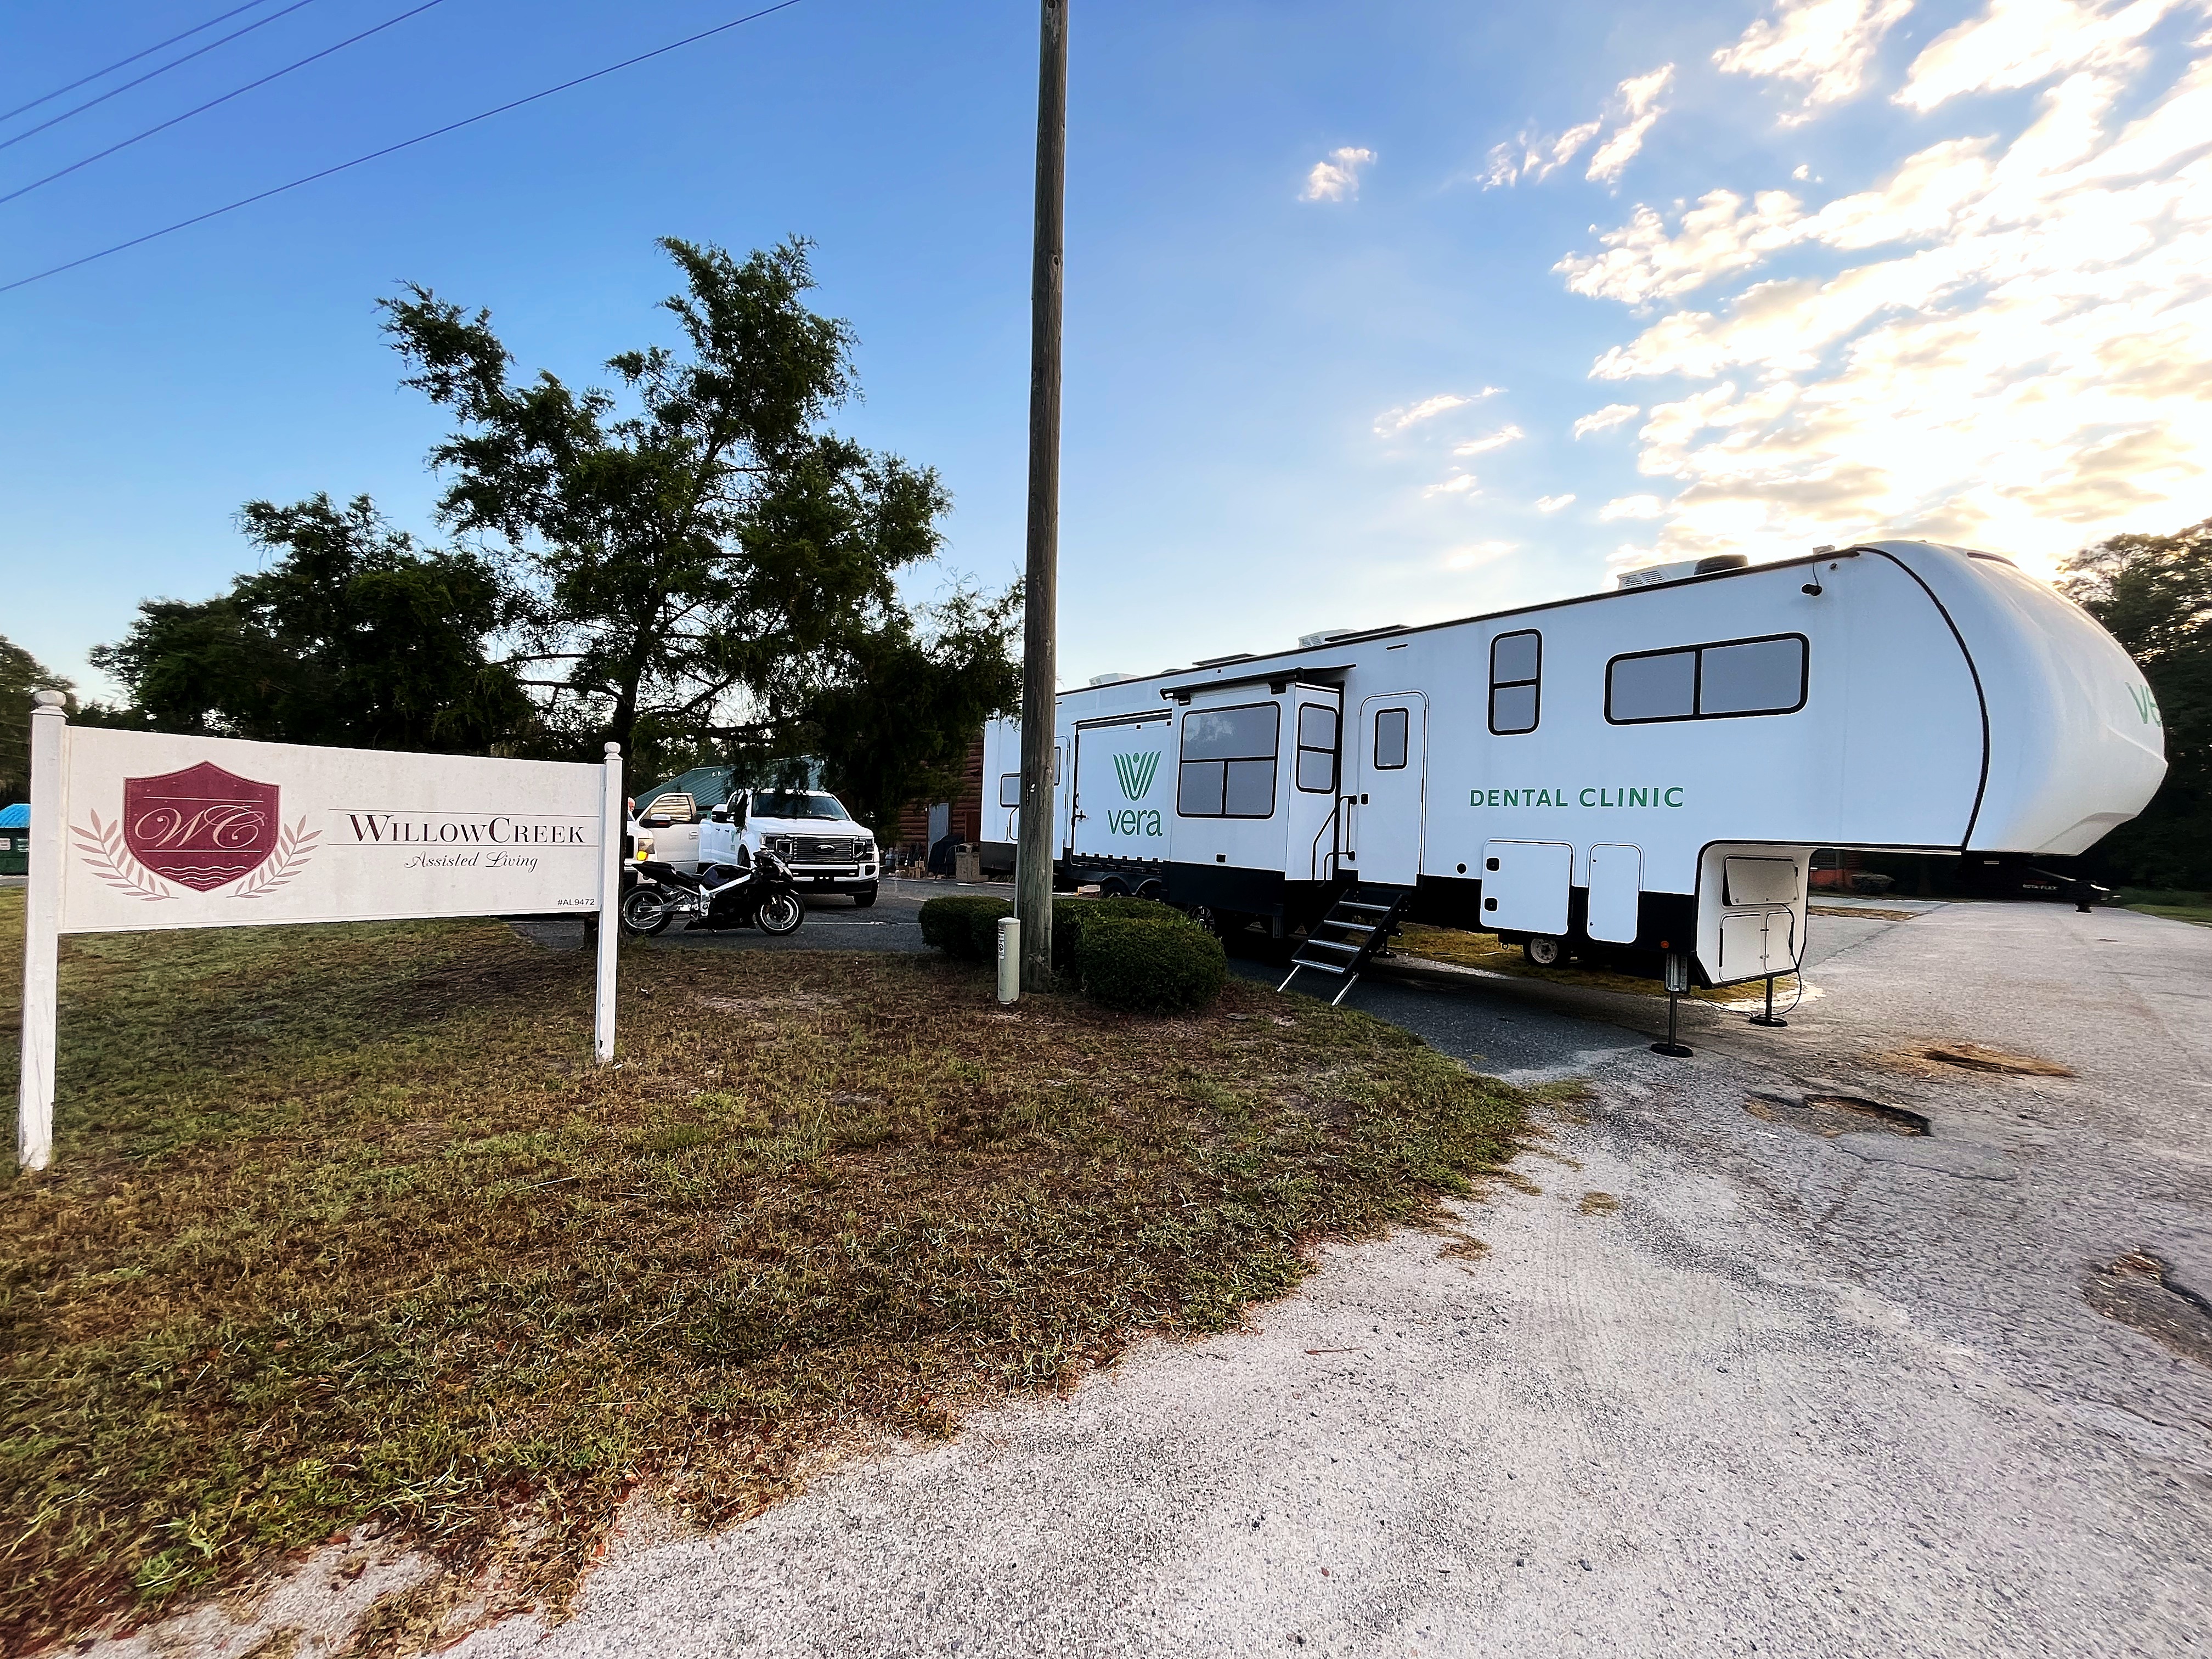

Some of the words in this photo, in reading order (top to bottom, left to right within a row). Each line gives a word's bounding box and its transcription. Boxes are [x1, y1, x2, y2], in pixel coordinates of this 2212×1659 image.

[1470, 789, 1568, 807] DENTAL
[1579, 787, 1684, 808] CLINIC
[1107, 809, 1163, 837] vera
[404, 851, 479, 868] Assisted
[484, 850, 539, 873] Living
